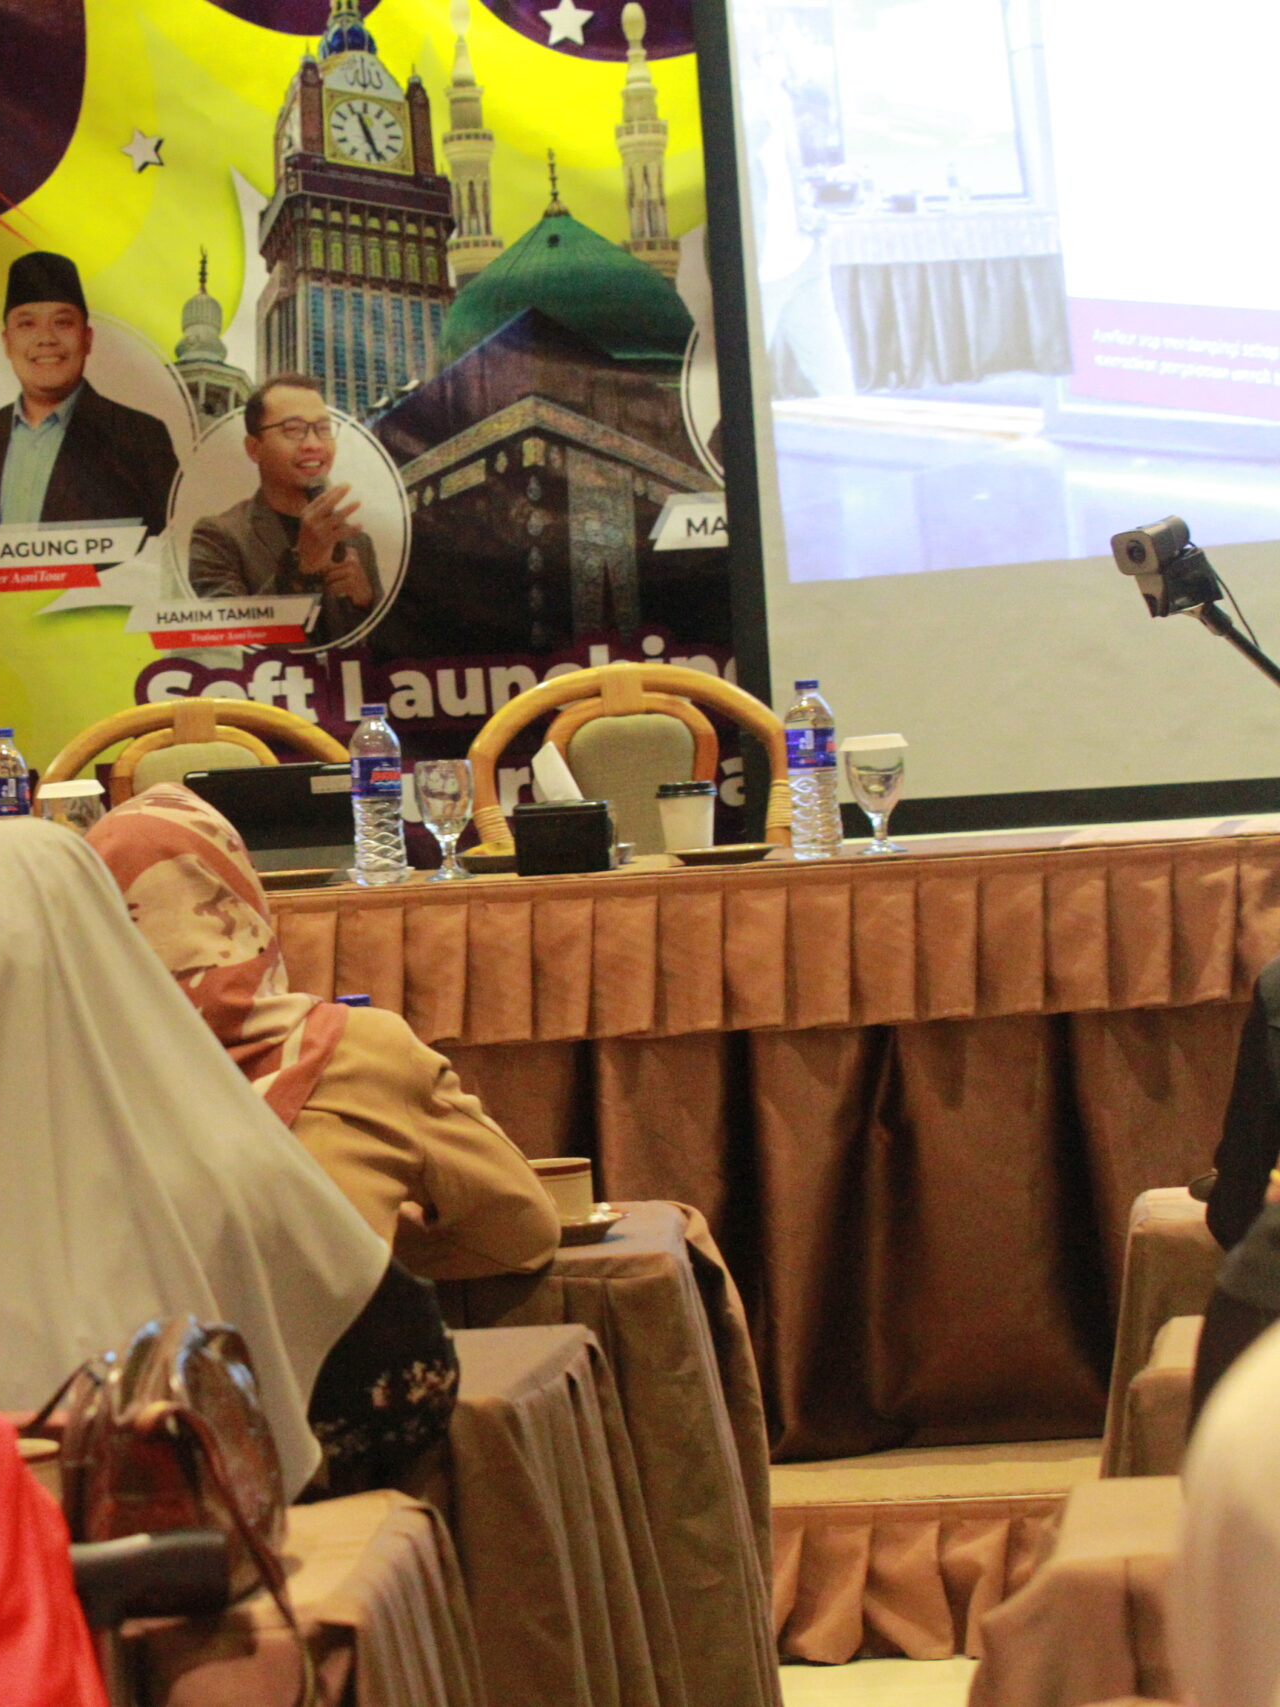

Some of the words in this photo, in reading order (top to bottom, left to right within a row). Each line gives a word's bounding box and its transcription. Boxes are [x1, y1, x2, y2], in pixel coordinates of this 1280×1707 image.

[0, 539, 78, 559] AGUNG
[85, 537, 114, 556] PP
[156, 609, 213, 625] HAMIM
[216, 606, 275, 622] TAMIMI
[340, 634, 738, 722] Launi
